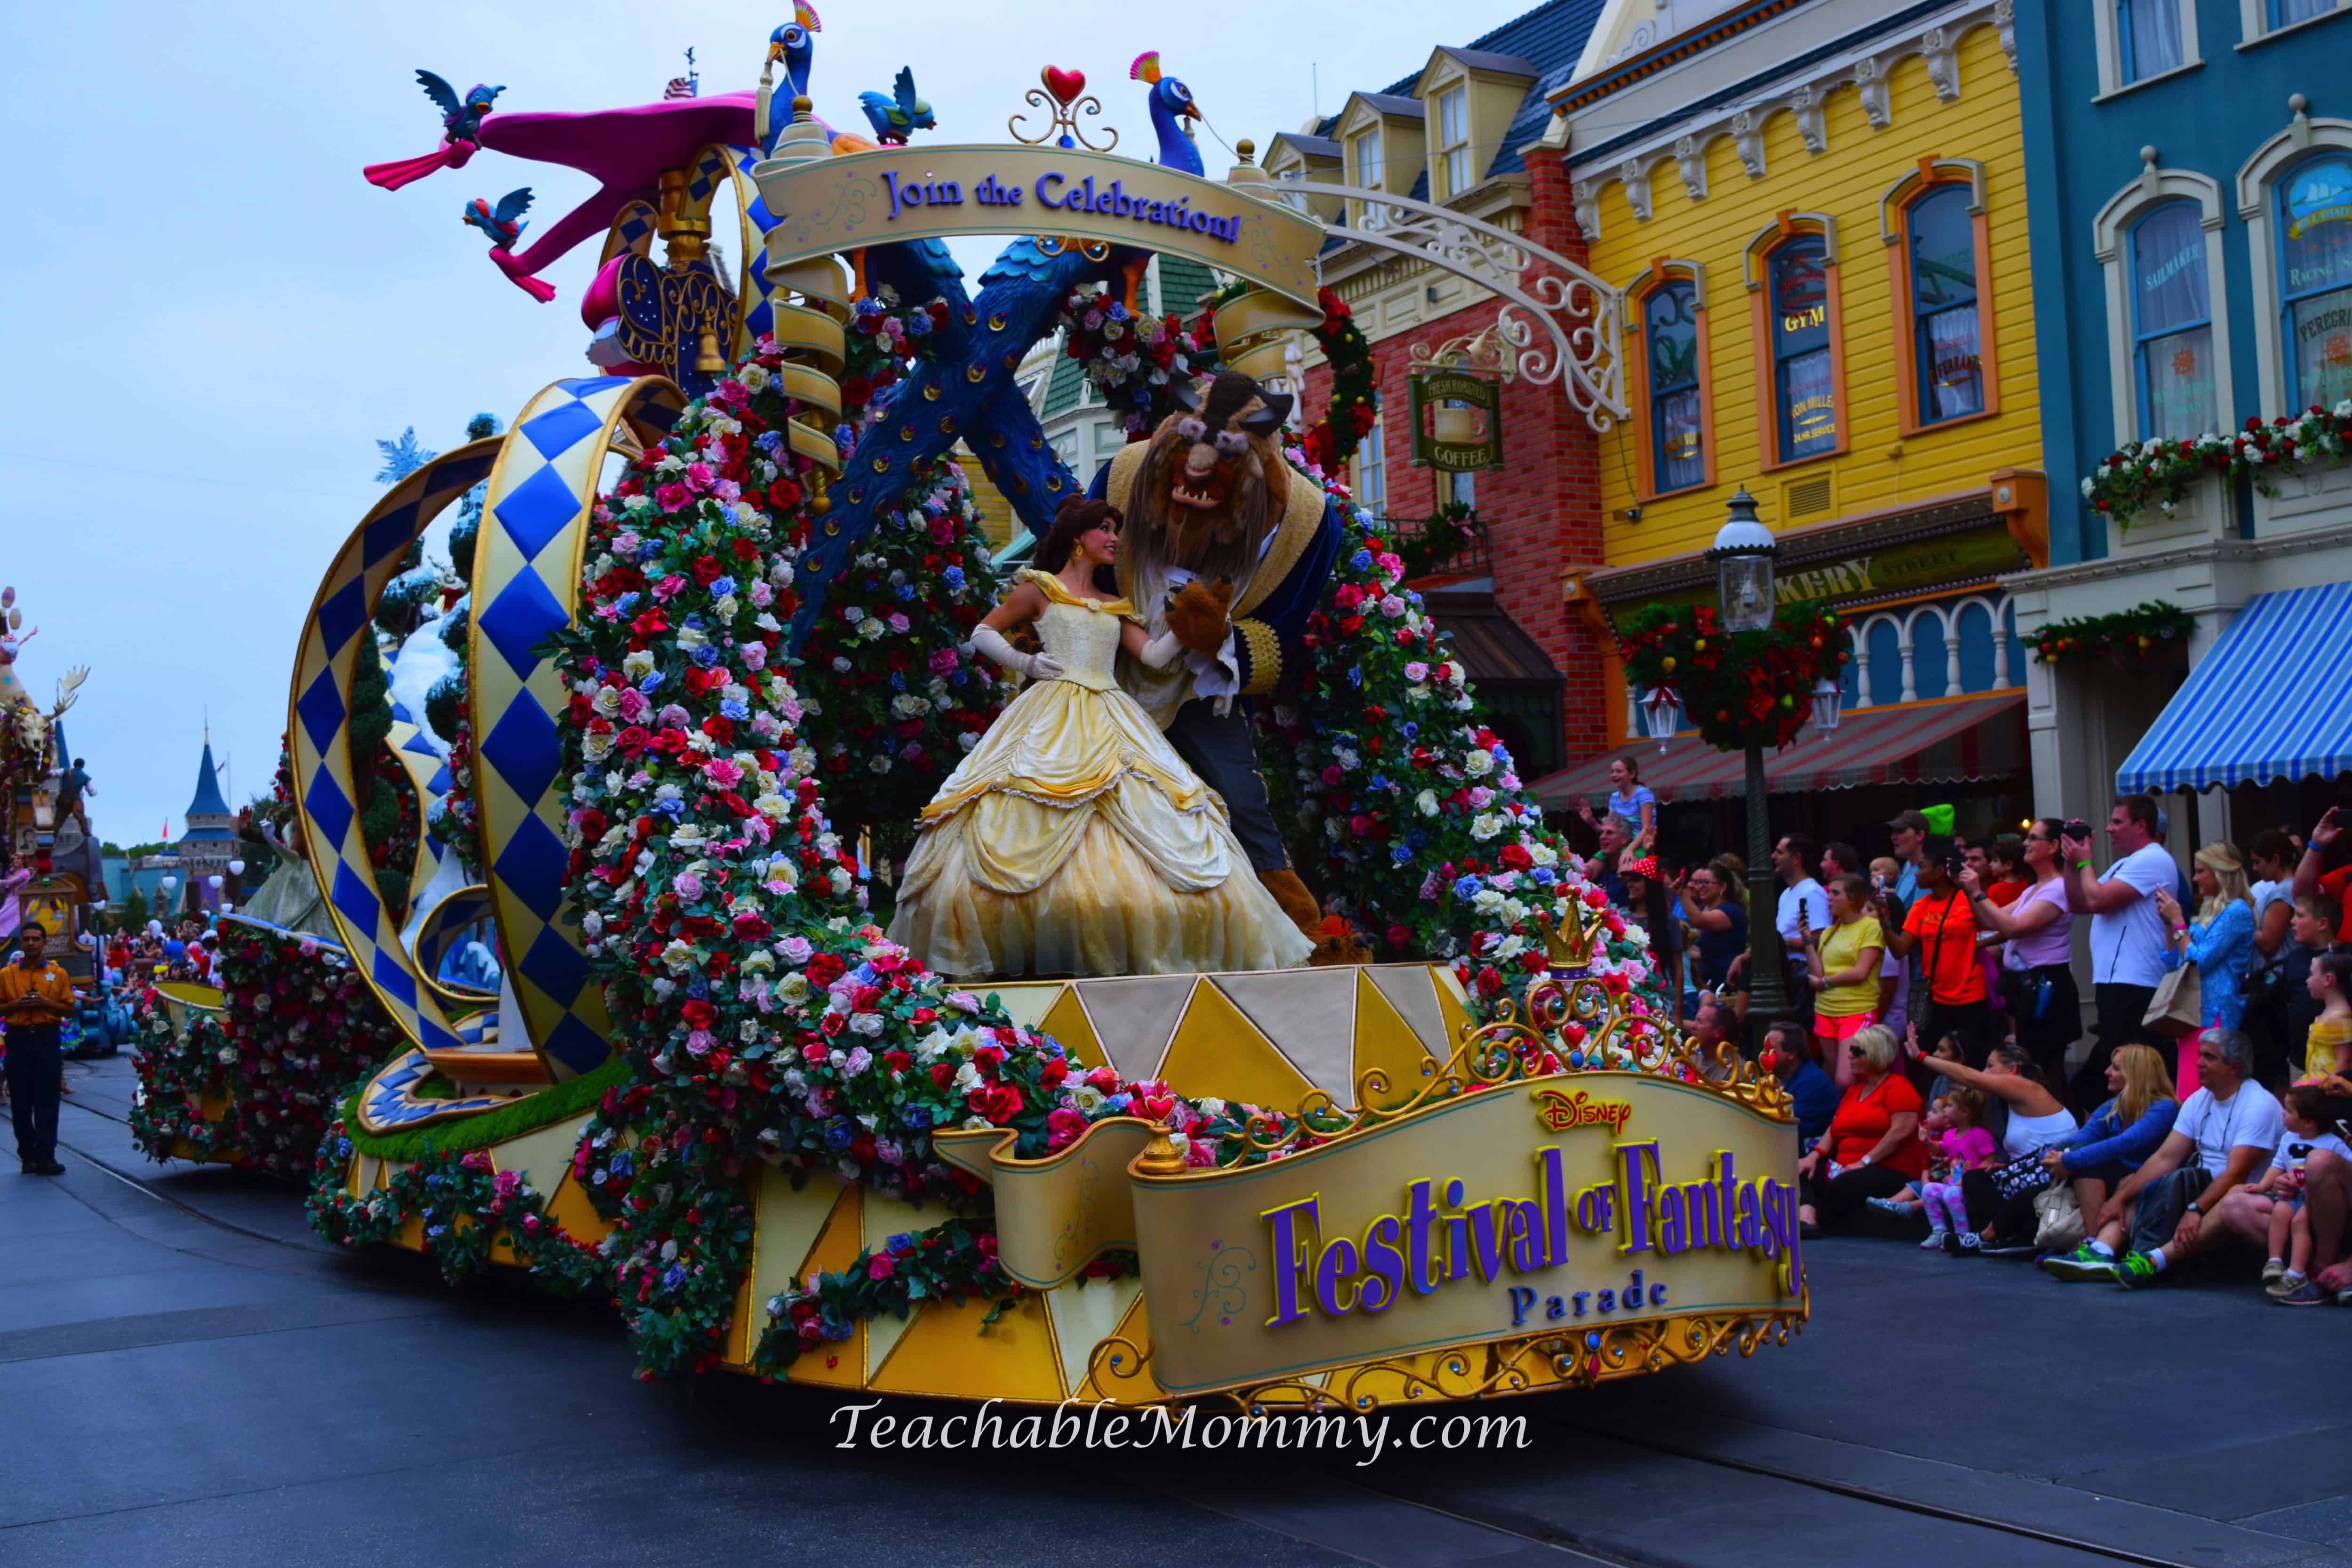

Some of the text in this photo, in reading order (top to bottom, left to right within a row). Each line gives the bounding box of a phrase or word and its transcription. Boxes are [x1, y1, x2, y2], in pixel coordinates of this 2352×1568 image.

[881, 170, 1241, 244] Join the Celebration!
[2145, 244, 2198, 292] SAILMAKER
[1785, 305, 1825, 332] GYM
[1428, 380, 1486, 400] FRESH ROASTED
[1435, 446, 1487, 467] COFFEE
[1883, 551, 1958, 575] STREET
[1534, 1089, 1631, 1136] Disney
[1259, 1145, 1568, 1329] Festival
[1613, 1138, 1801, 1297] Fantasy
[1510, 1270, 1668, 1326] Parade
